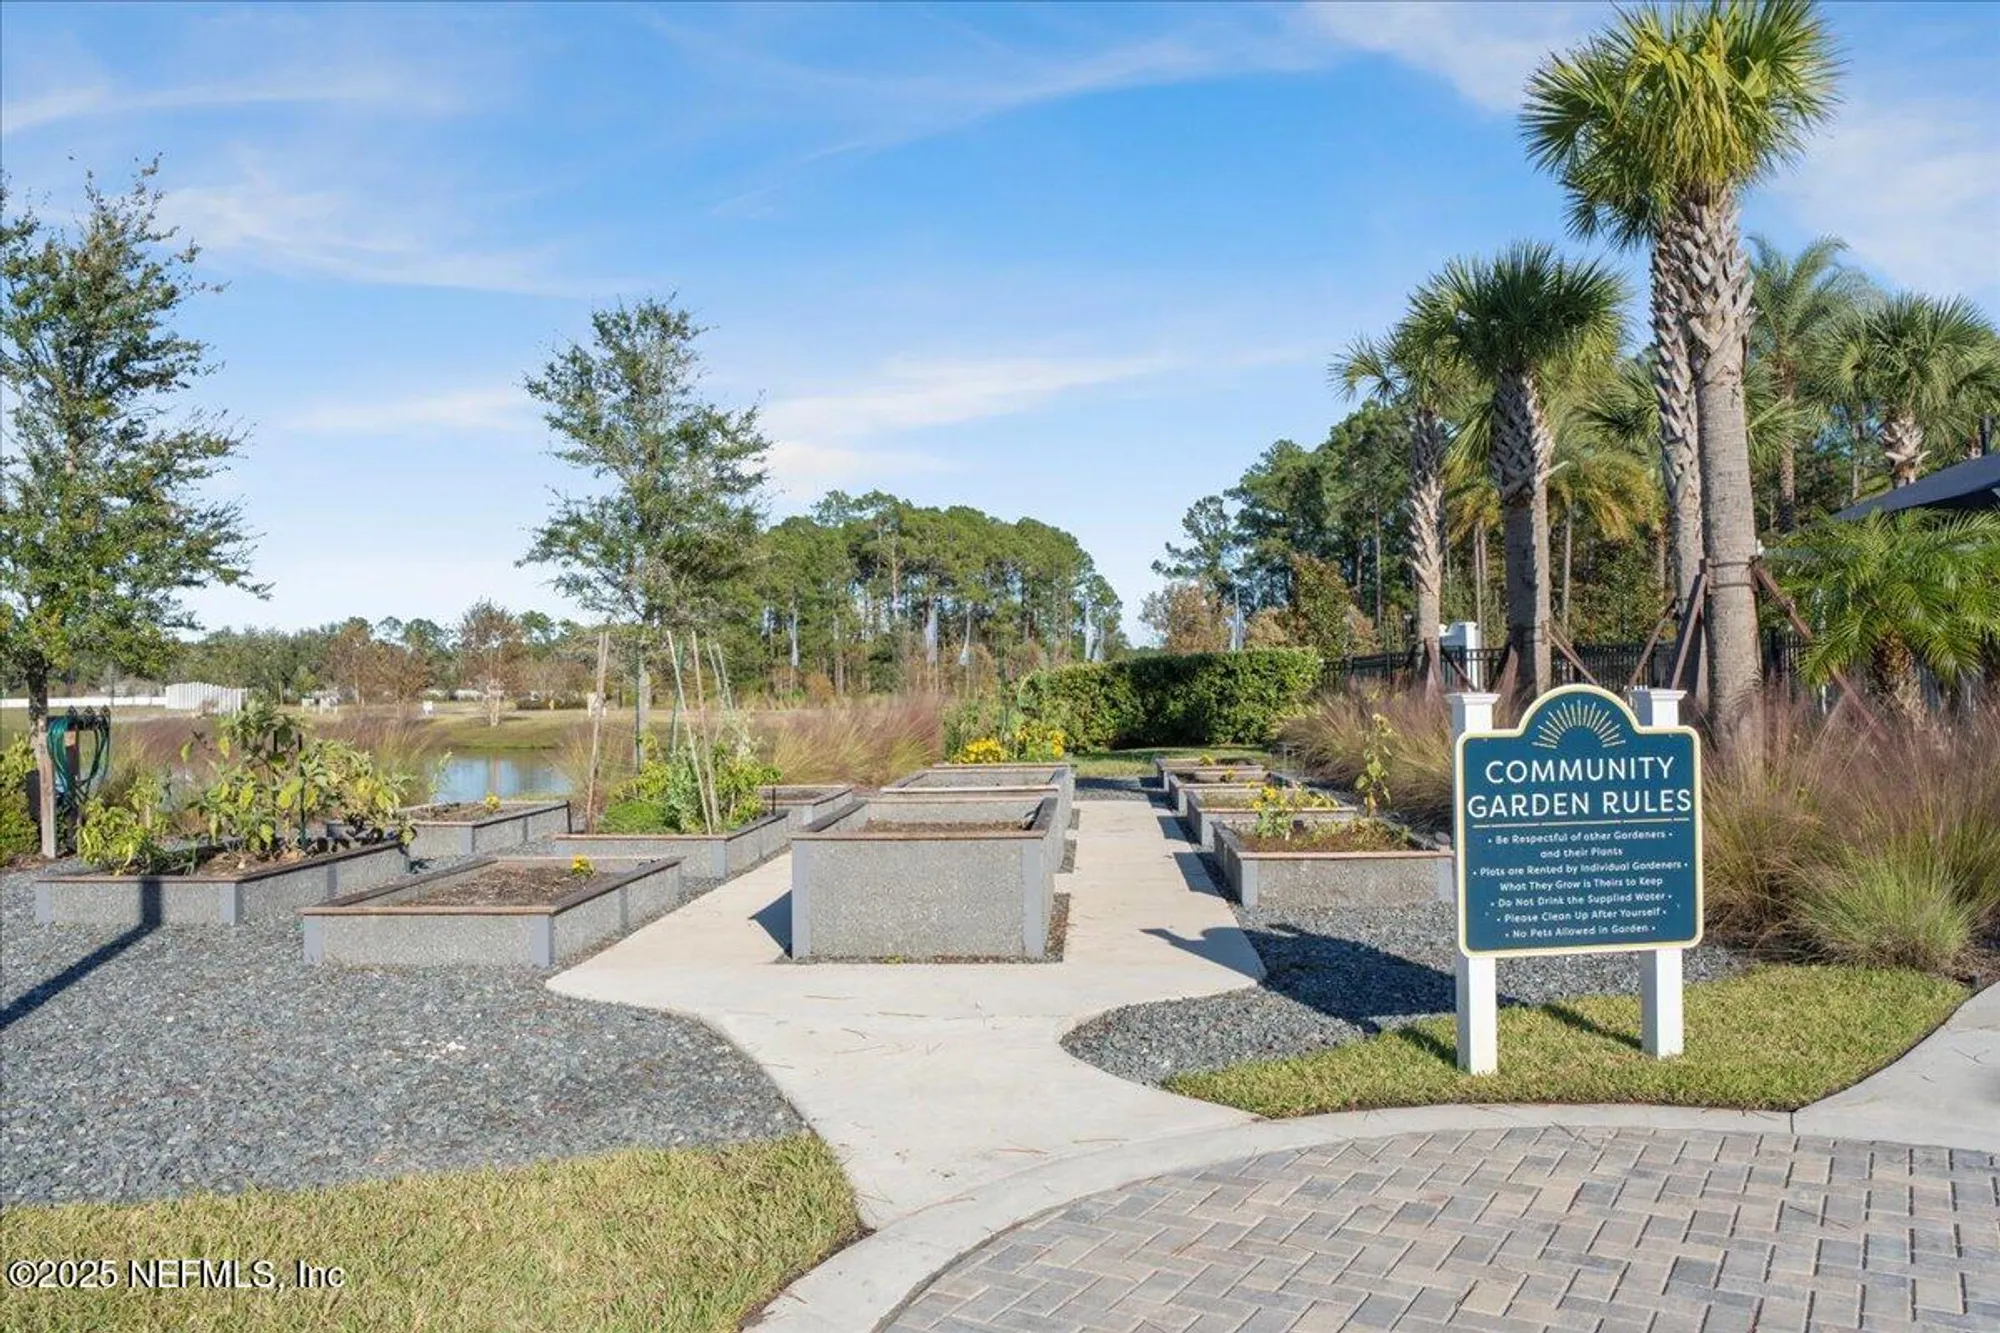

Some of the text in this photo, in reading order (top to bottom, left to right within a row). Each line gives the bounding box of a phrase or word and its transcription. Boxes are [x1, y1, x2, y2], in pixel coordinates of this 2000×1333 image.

[1485, 757, 1674, 783] COMMUNITY
[1467, 789, 1692, 818] GARDEN RULES
[1496, 831, 1665, 845] Be Respectful of other Gardeners
[1540, 847, 1623, 858] and their Plants
[1480, 866, 1505, 877] Plots
[1527, 864, 1562, 874] Rented
[1566, 864, 1577, 876] by
[1581, 862, 1629, 872] Individual
[1632, 861, 1682, 871] Gardeners
[1500, 877, 1662, 892] What They Grow is Theirs to Keep
[1498, 892, 1665, 907] Do Not Drink the Supplied Water
[1505, 908, 1660, 923] Please Clean Up After Yourself
[1513, 924, 1648, 938] No Pets Allowed in Garden
